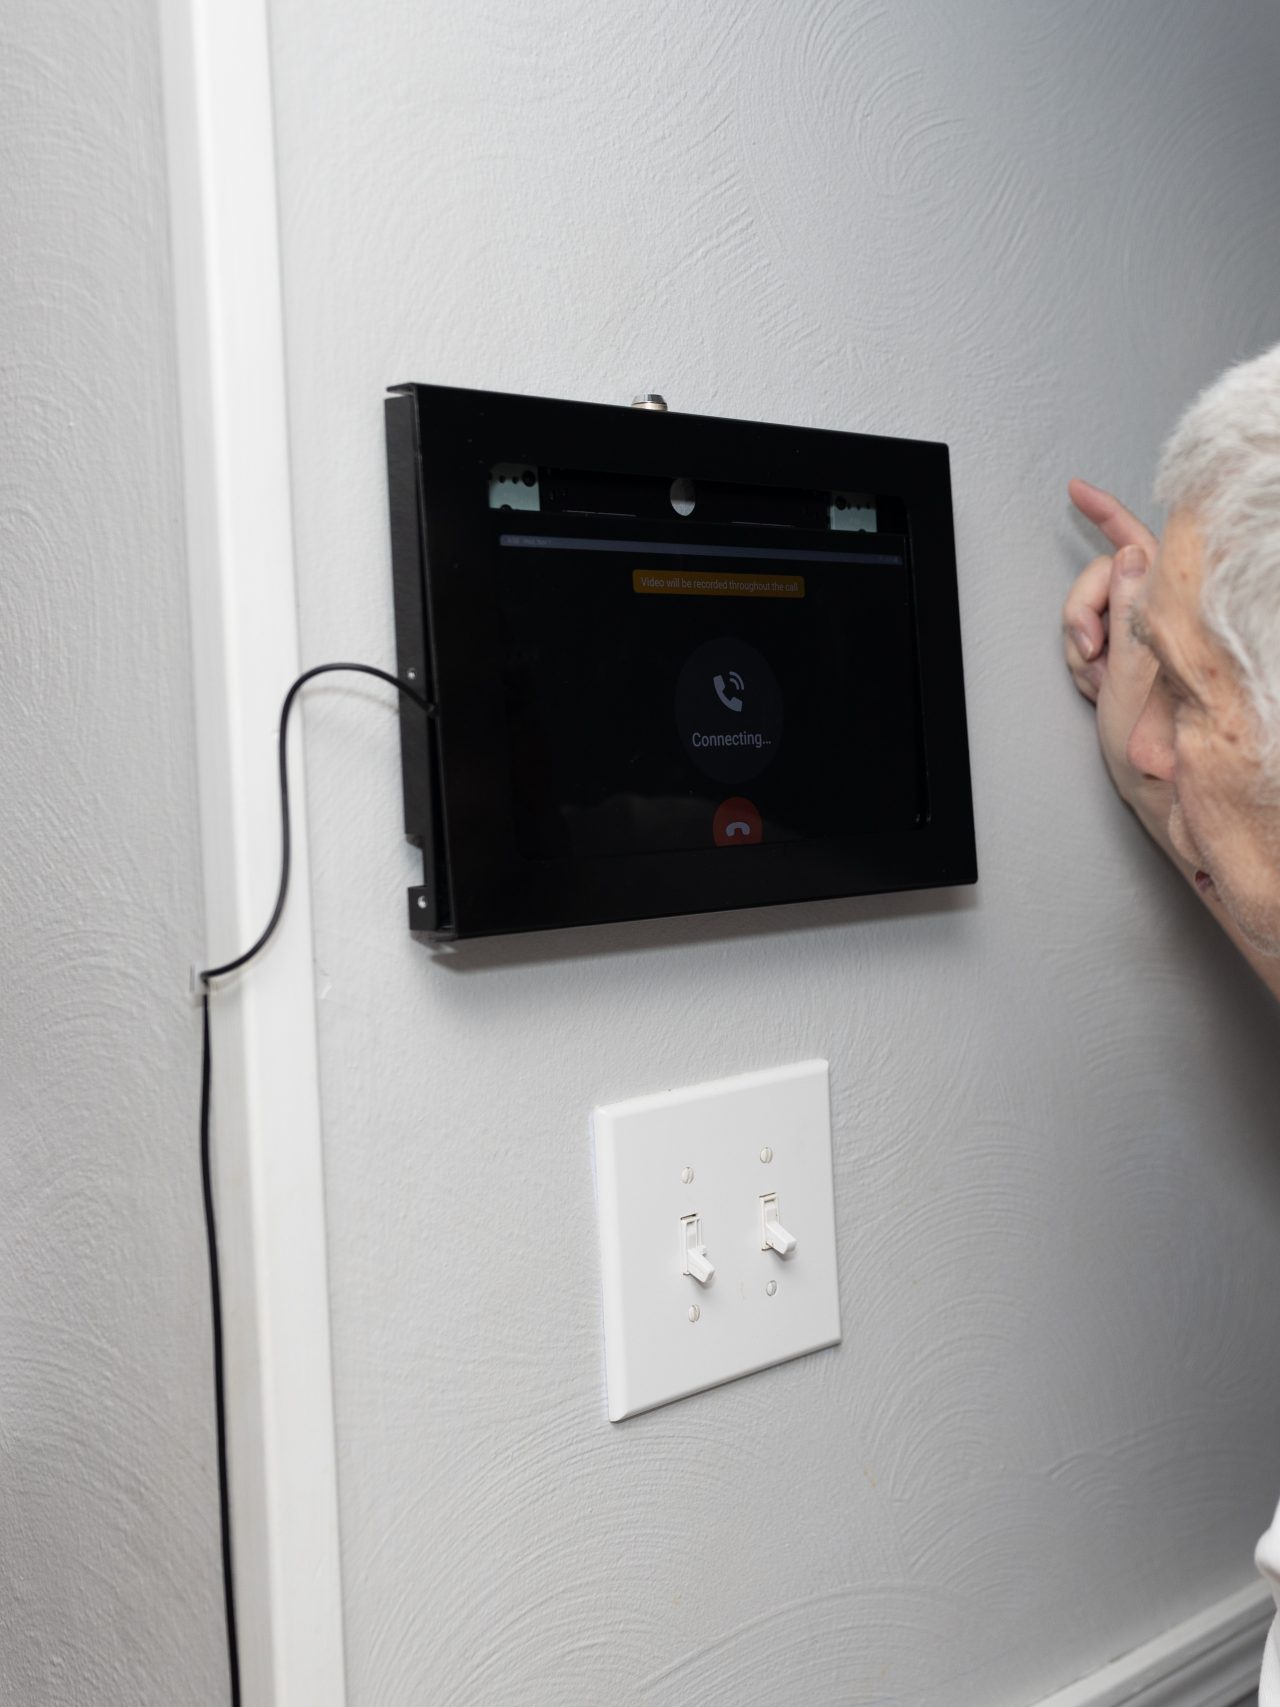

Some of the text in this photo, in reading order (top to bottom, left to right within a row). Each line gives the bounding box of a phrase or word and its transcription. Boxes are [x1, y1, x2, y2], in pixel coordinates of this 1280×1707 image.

[640, 576, 798, 592] Video will be recorded throughout the call
[692, 730, 772, 749] Connecting...
